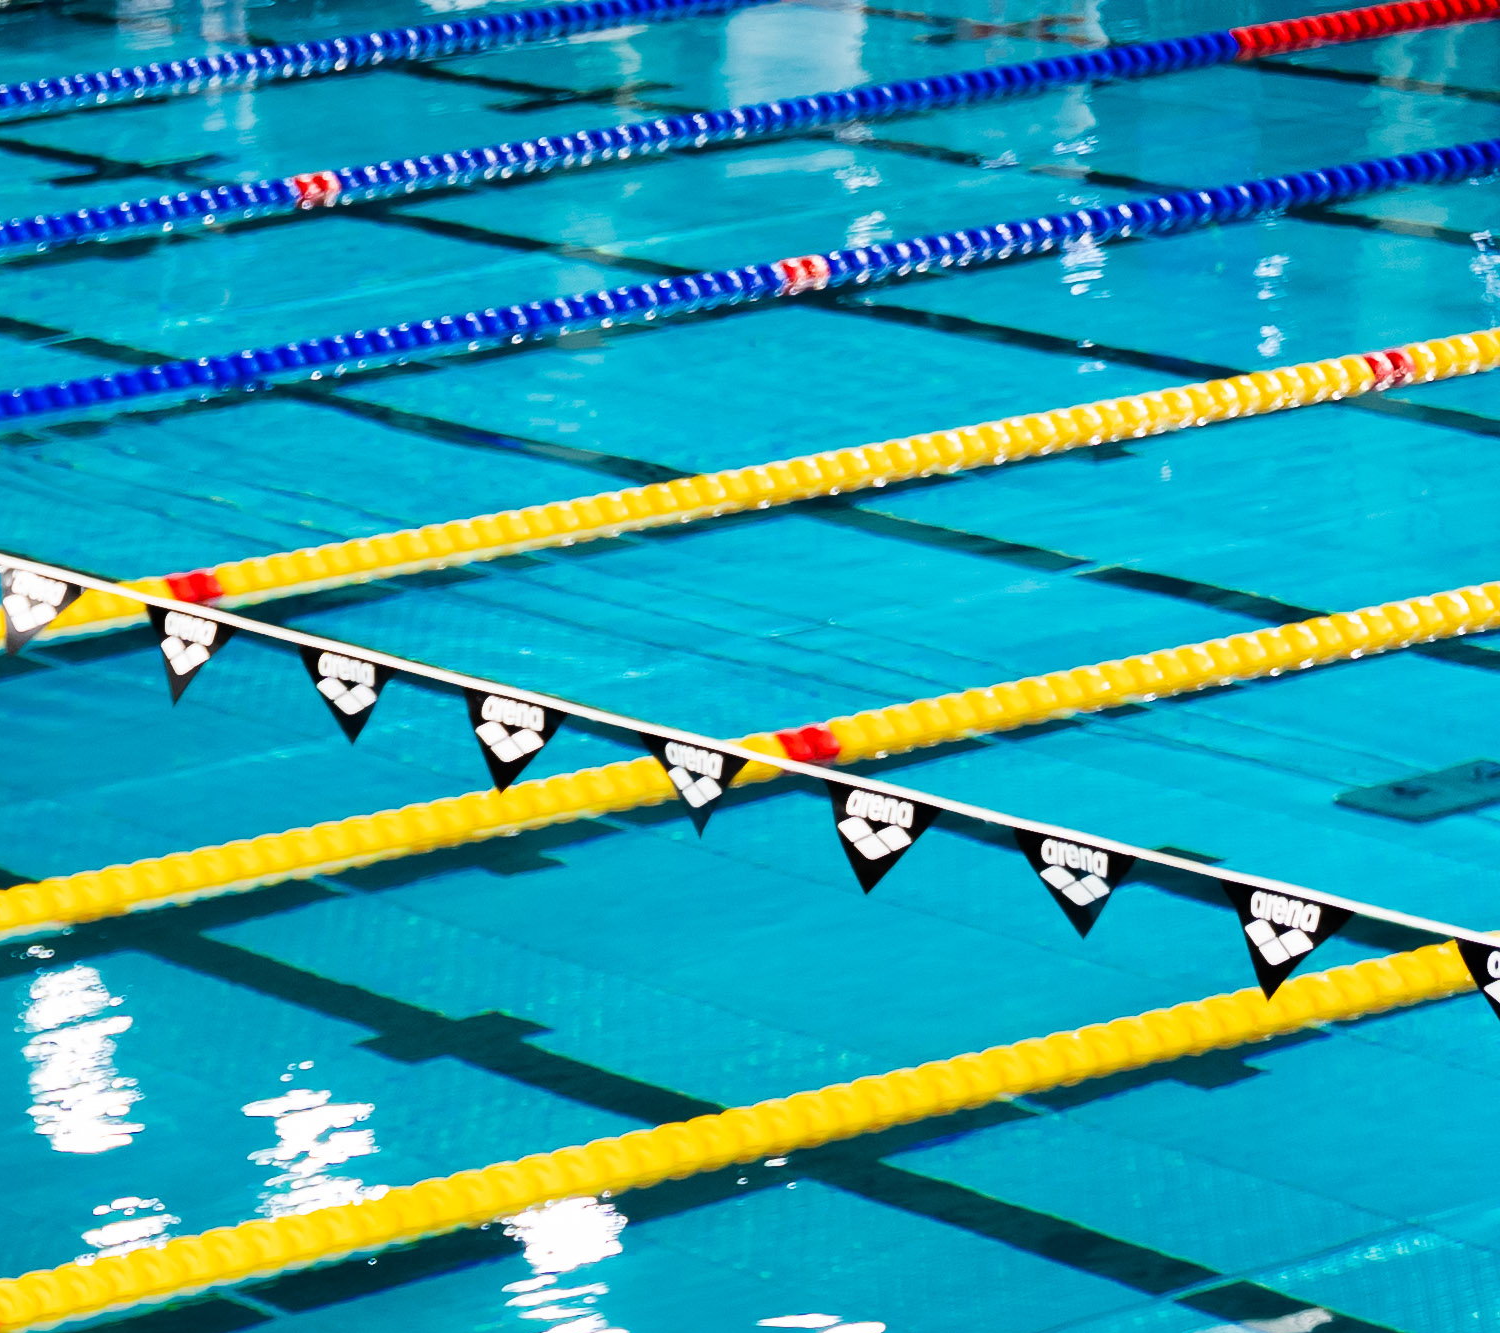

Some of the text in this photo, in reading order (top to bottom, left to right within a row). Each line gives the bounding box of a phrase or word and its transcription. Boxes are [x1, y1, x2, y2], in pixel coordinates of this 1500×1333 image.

[318, 652, 376, 687] arena
[481, 694, 544, 732] arena
[665, 742, 723, 779] arena
[845, 790, 914, 828] arena
[1040, 838, 1109, 878] arena
[1250, 890, 1320, 932] arena
